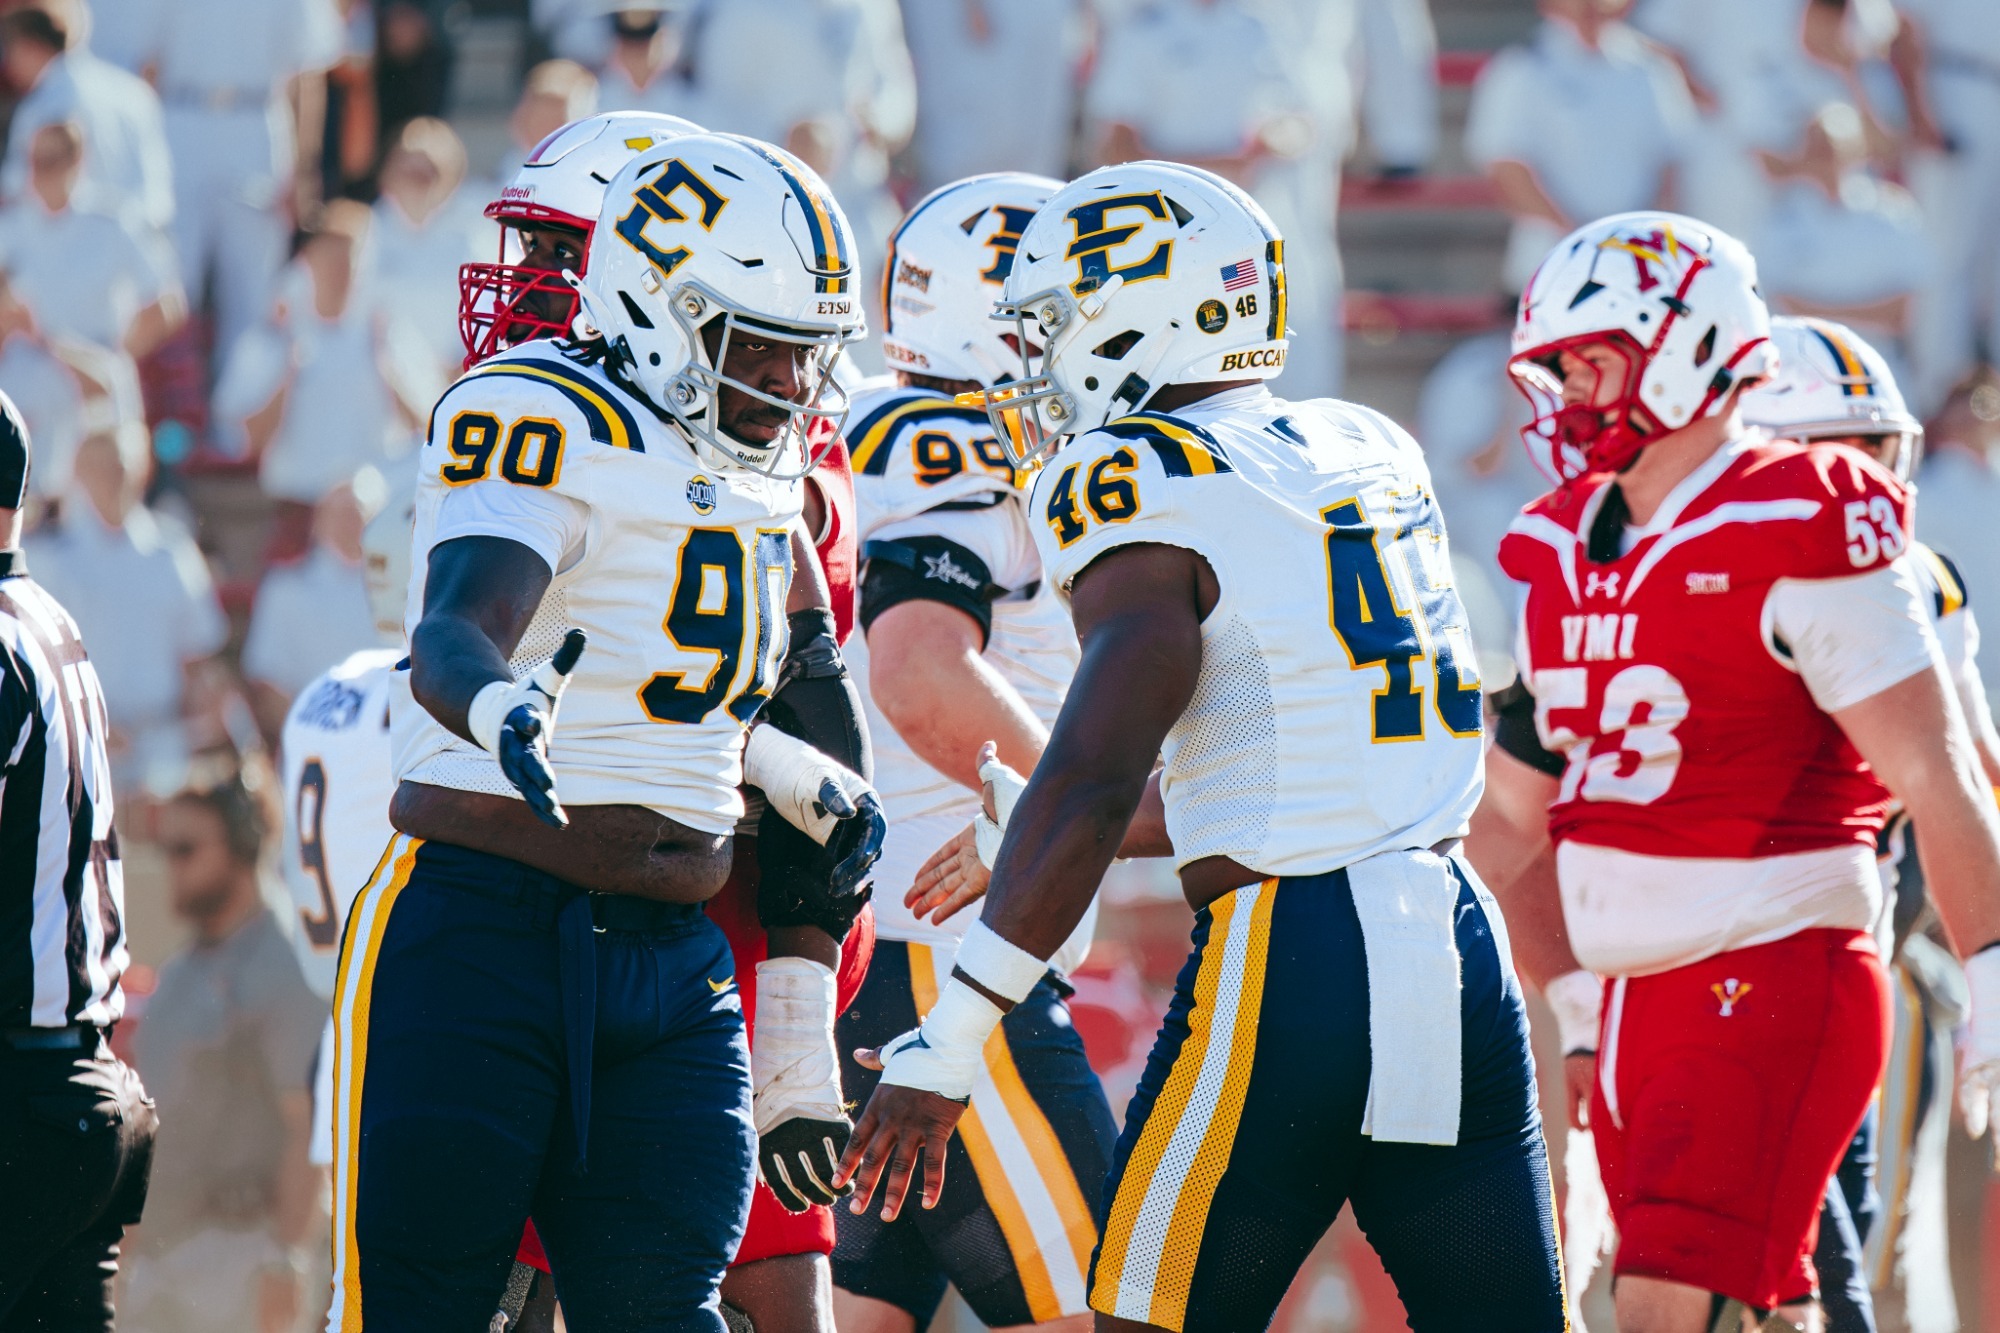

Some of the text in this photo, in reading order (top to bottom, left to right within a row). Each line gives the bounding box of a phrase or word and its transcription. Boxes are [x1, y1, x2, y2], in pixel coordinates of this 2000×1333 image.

[817, 301, 851, 315] ETSU
[1235, 293, 1257, 319] 46
[440, 410, 565, 489] 90
[737, 451, 768, 463] Riddell
[1046, 446, 1142, 551] 46
[1844, 496, 1906, 568] 53
[1561, 613, 1639, 662] VMI
[1533, 664, 1691, 806] 53
